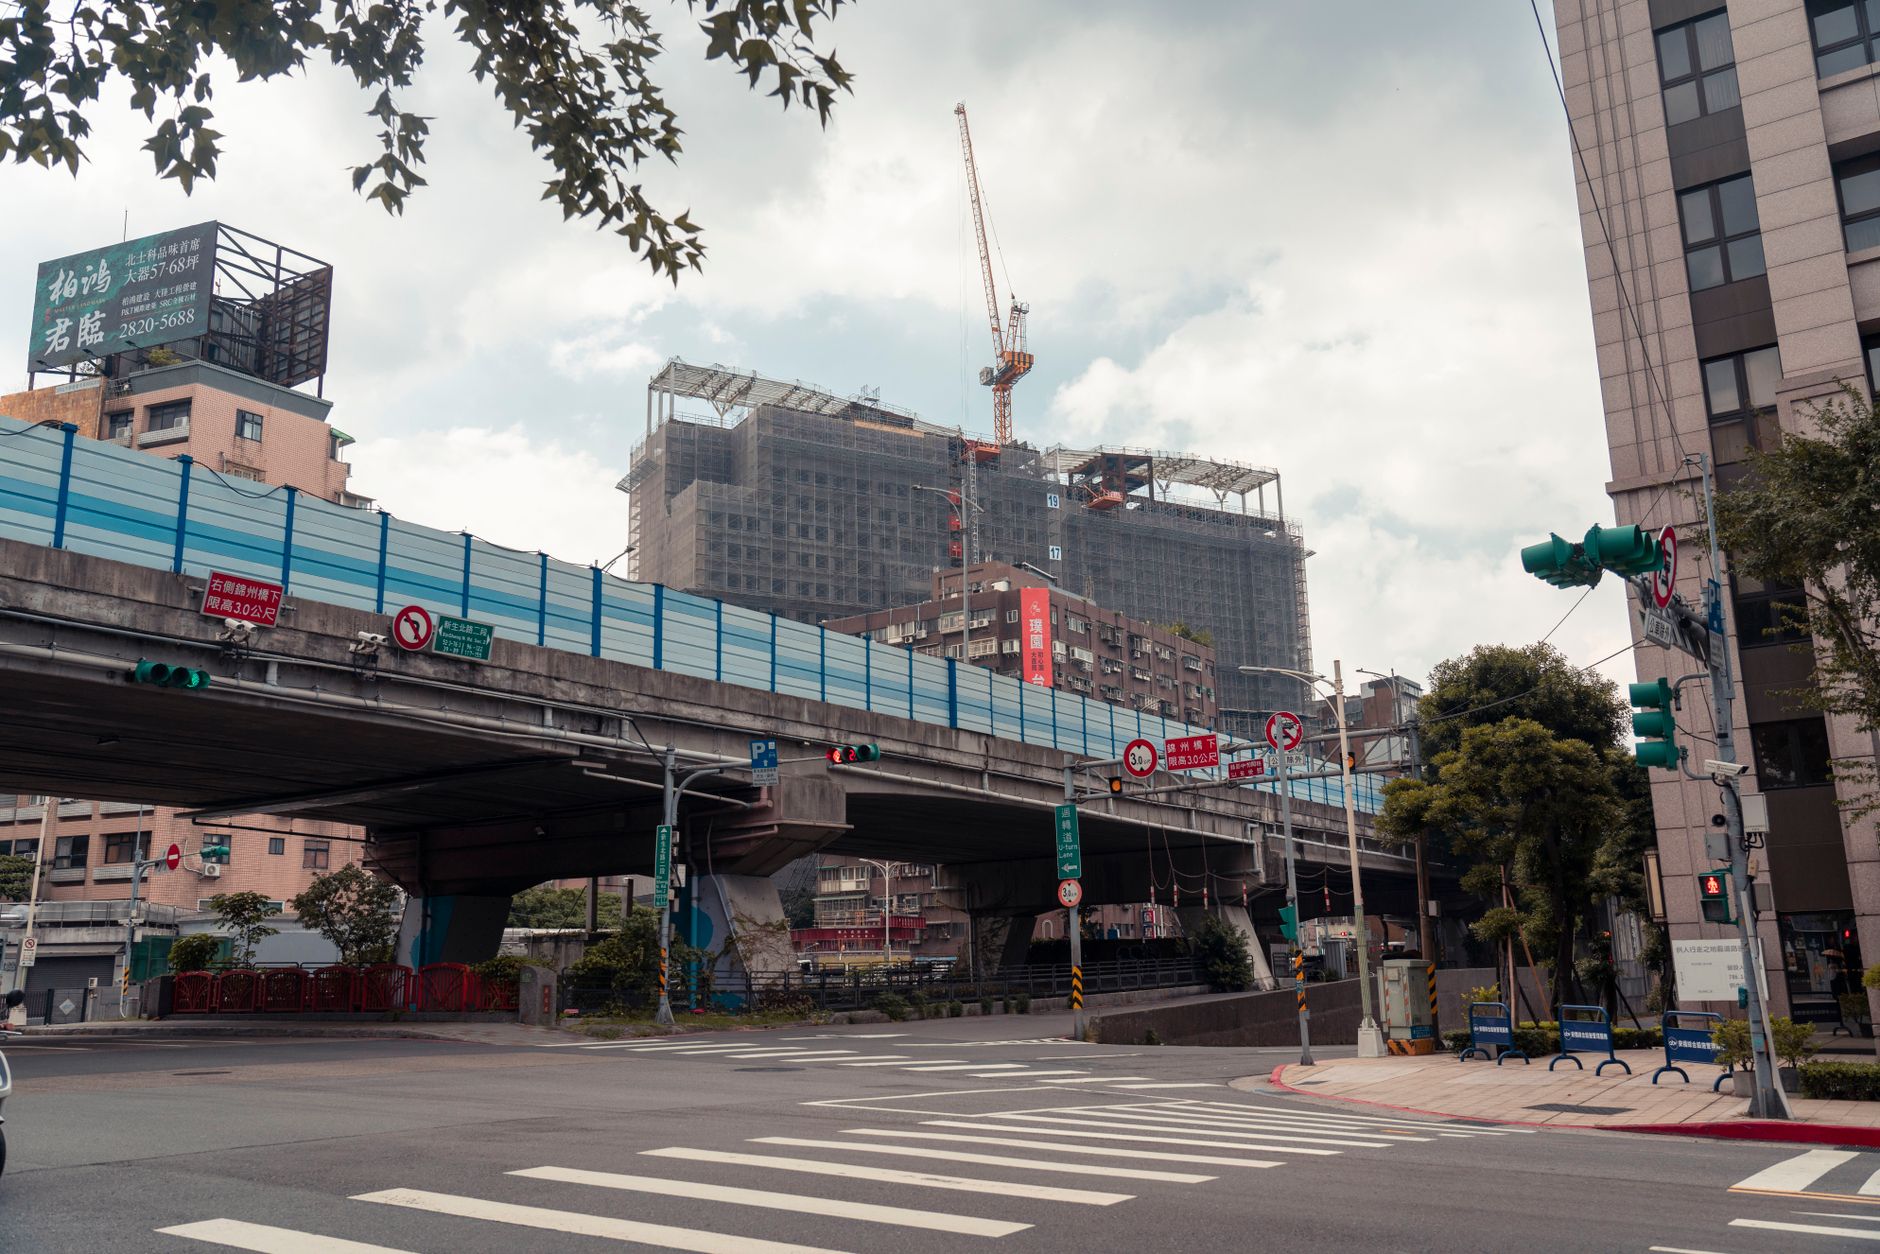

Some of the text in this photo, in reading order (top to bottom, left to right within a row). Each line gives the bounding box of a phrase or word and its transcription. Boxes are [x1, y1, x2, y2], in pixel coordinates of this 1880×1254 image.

[119, 308, 195, 338] 2820-5688
[44, 310, 106, 356] 君臨
[1048, 495, 1058, 507] 19
[1050, 547, 1060, 559] 17
[211, 579, 280, 603] 右側錦州橋下
[206, 595, 276, 621] 限高3.0公尺
[444, 620, 488, 637] 新生北路二段
[752, 742, 766, 760] P
[1167, 738, 1216, 754] 錦州橋下
[1168, 751, 1218, 767] 限高3.0公尺
[1271, 756, 1302, 766] 公除外
[1059, 851, 1073, 859] Lane
